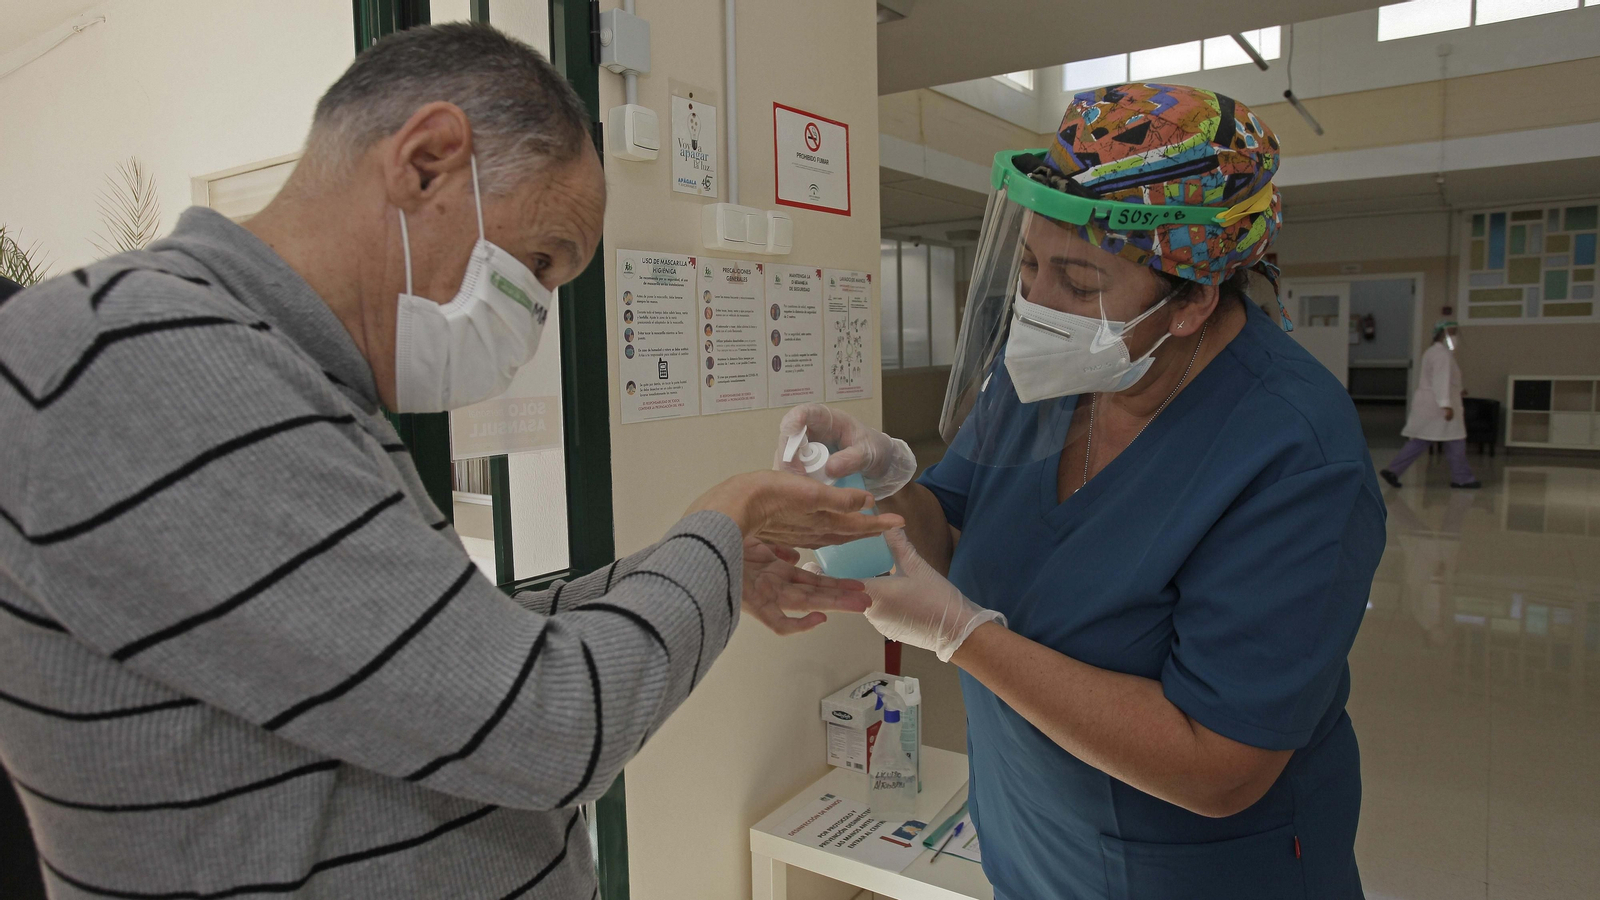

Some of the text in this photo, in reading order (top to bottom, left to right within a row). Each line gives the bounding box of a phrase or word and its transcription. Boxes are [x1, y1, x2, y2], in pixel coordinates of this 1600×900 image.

[677, 137, 702, 153] Voy a
[680, 148, 709, 163] apagar
[796, 152, 829, 165] PROHIBIDO FUMAR
[660, 259, 688, 267] MASCARILLA
[652, 267, 677, 275] HIGIÉNICA
[722, 267, 752, 275] PRECAUCIONES
[725, 275, 748, 283] GENERALES
[788, 812, 821, 836] DESINFECCIÓN
[824, 799, 842, 811] MANOS
[817, 830, 829, 838] POR
[827, 812, 853, 832] PROTOCOLO
[819, 827, 848, 848] PREVENCIÓN
[835, 818, 875, 848] LAS MANOS ANTES
[847, 836, 867, 849] ENTRAR
